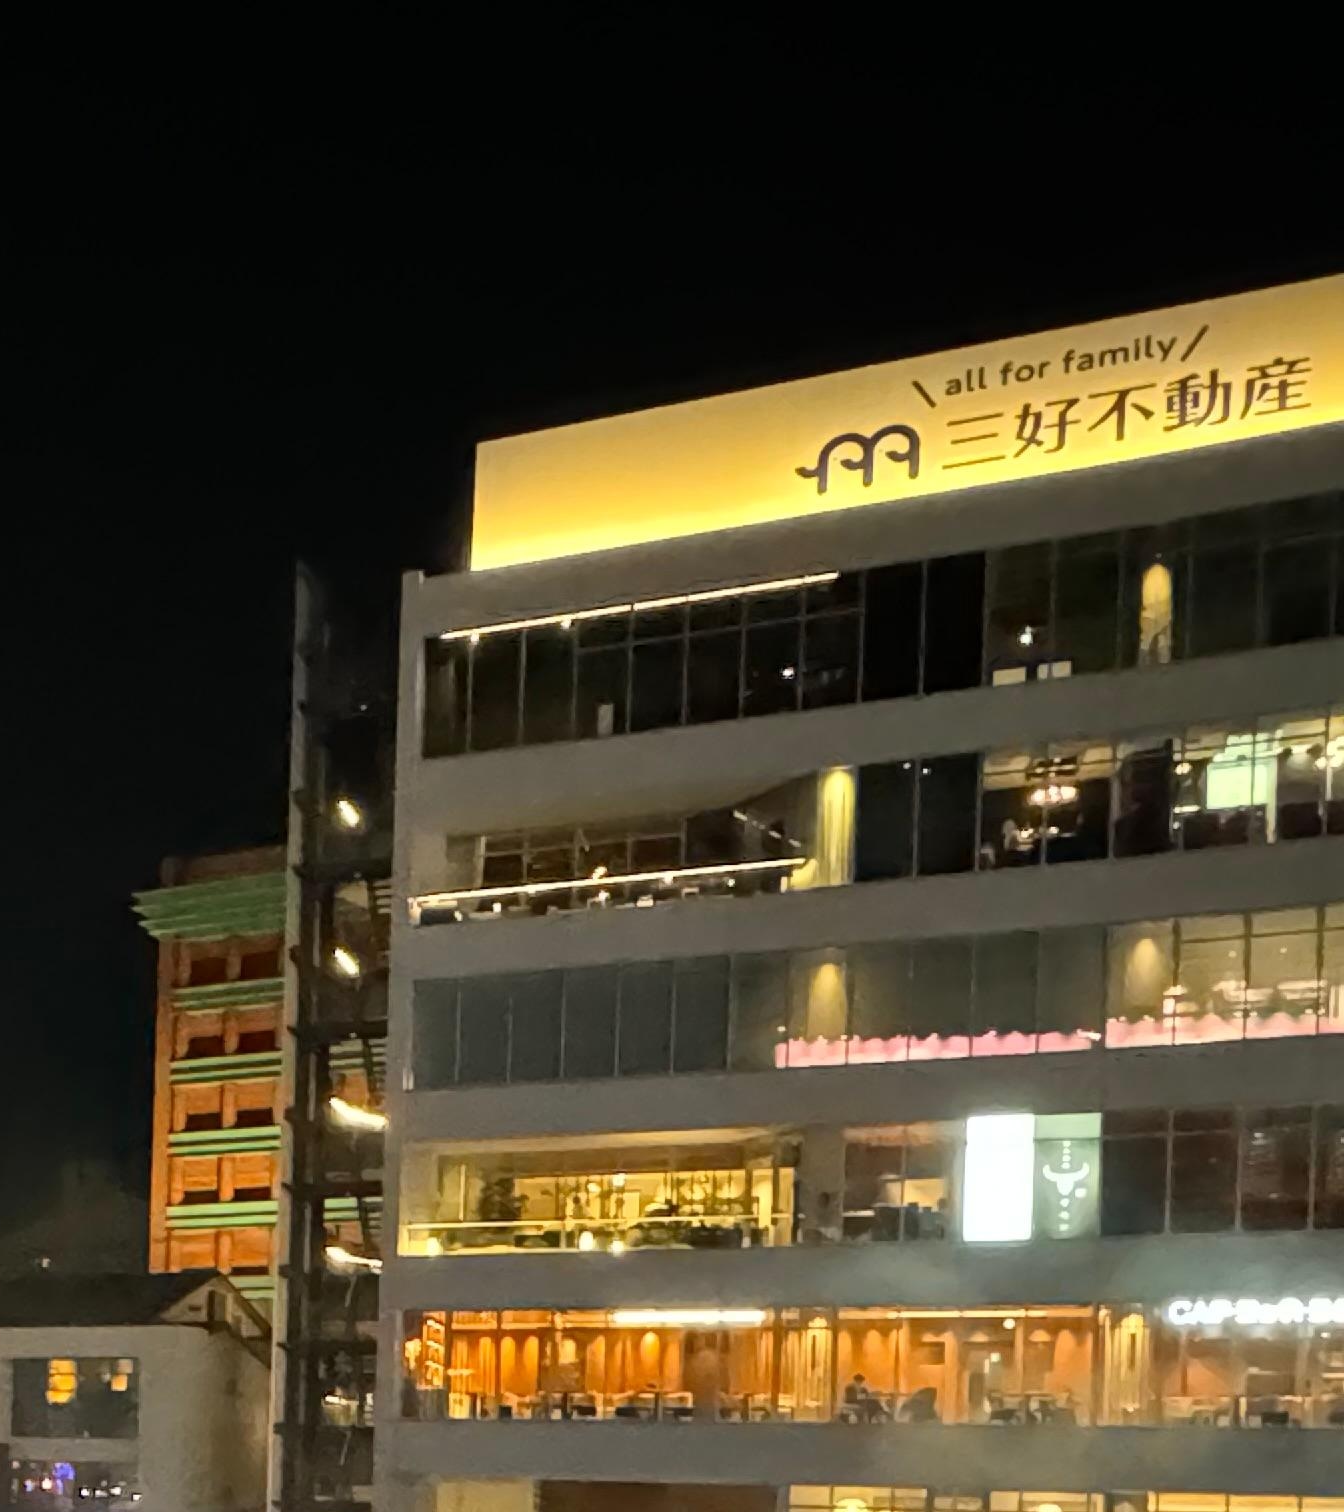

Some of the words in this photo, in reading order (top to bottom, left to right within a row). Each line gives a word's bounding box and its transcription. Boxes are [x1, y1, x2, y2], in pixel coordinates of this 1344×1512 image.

[944, 366, 988, 397] all
[999, 360, 1051, 387] for
[1062, 334, 1178, 375] family
[941, 356, 1313, 471] 三好不動産
